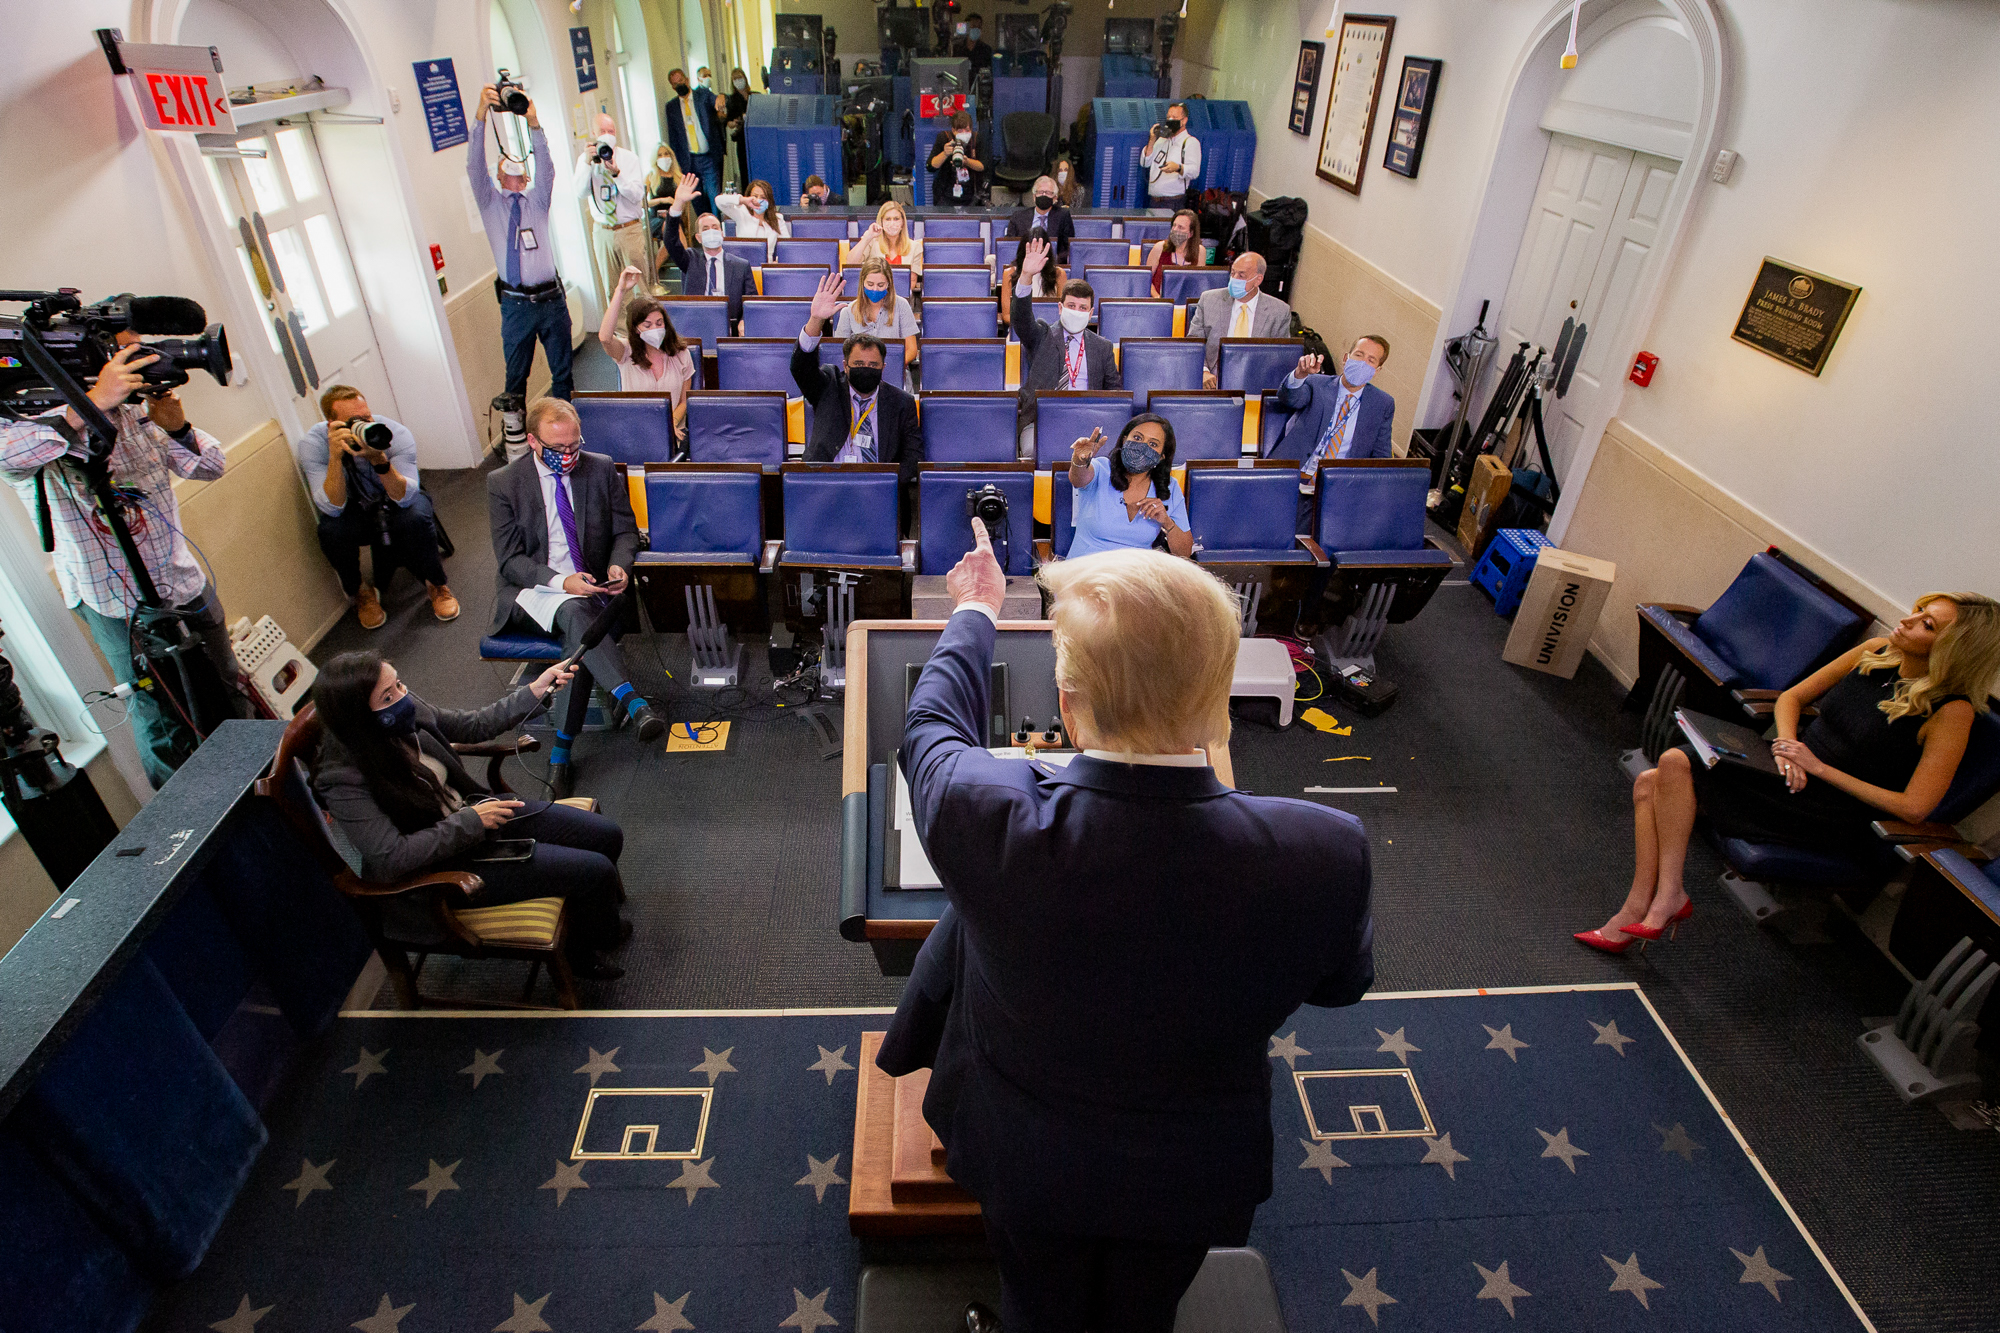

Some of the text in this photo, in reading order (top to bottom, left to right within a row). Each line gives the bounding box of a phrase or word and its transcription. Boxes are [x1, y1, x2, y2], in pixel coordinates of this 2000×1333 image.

[144, 72, 217, 126] EXIT
[1756, 298, 1824, 330] PRESS BRIEFING ROOM
[1764, 290, 1787, 304] JAMES
[1798, 302, 1825, 318] BRADY
[1537, 583, 1580, 665] UNIVISION
